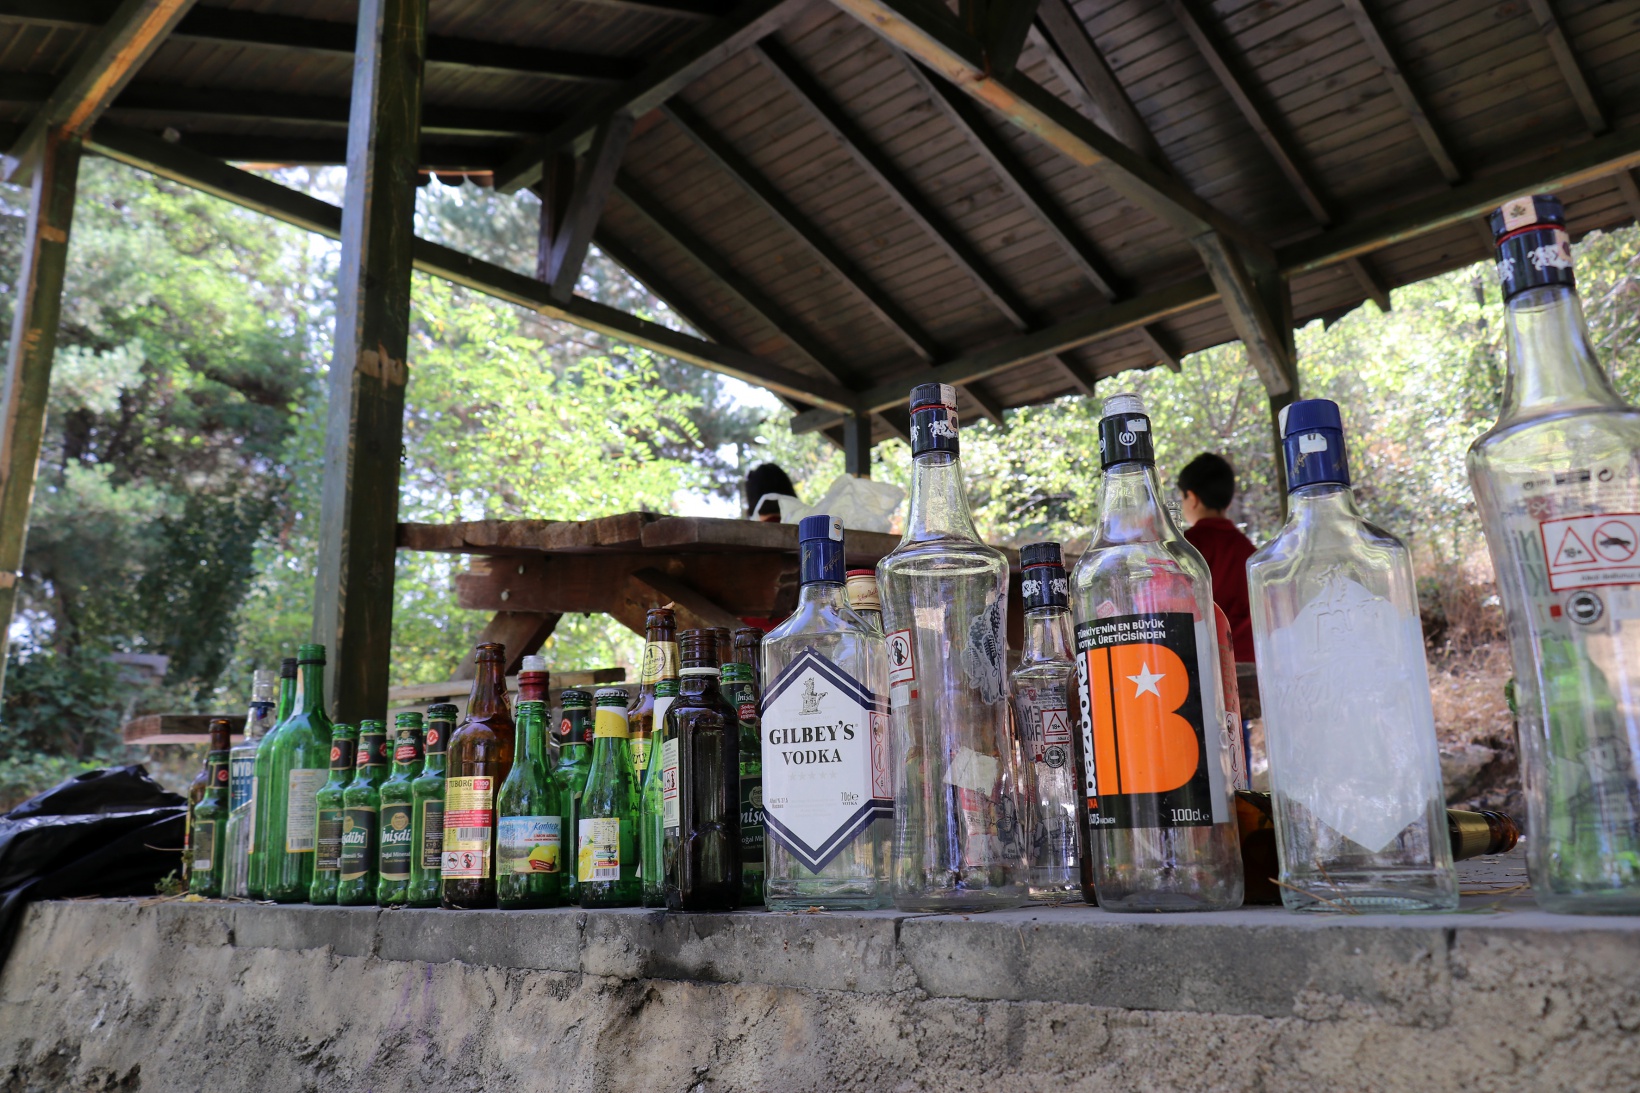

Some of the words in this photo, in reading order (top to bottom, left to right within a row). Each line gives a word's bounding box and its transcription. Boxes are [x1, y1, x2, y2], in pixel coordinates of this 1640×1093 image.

[1077, 623, 1117, 640] TÜRKİYE'NİN
[1118, 623, 1130, 632] EN
[1132, 619, 1165, 630] BÜYÜK
[1078, 639, 1097, 650] VOTKA
[1098, 631, 1166, 645] ÜRETİCİSİNDEN
[769, 720, 855, 745] GILBEY'S
[1051, 723, 1061, 731] 18+
[1077, 651, 1098, 797] bazooka
[781, 748, 843, 766] VODKA
[449, 779, 473, 788] TUBORG
[1171, 808, 1202, 822] 100cl
[381, 827, 412, 844] İnişdi
[741, 835, 754, 845] oğal
